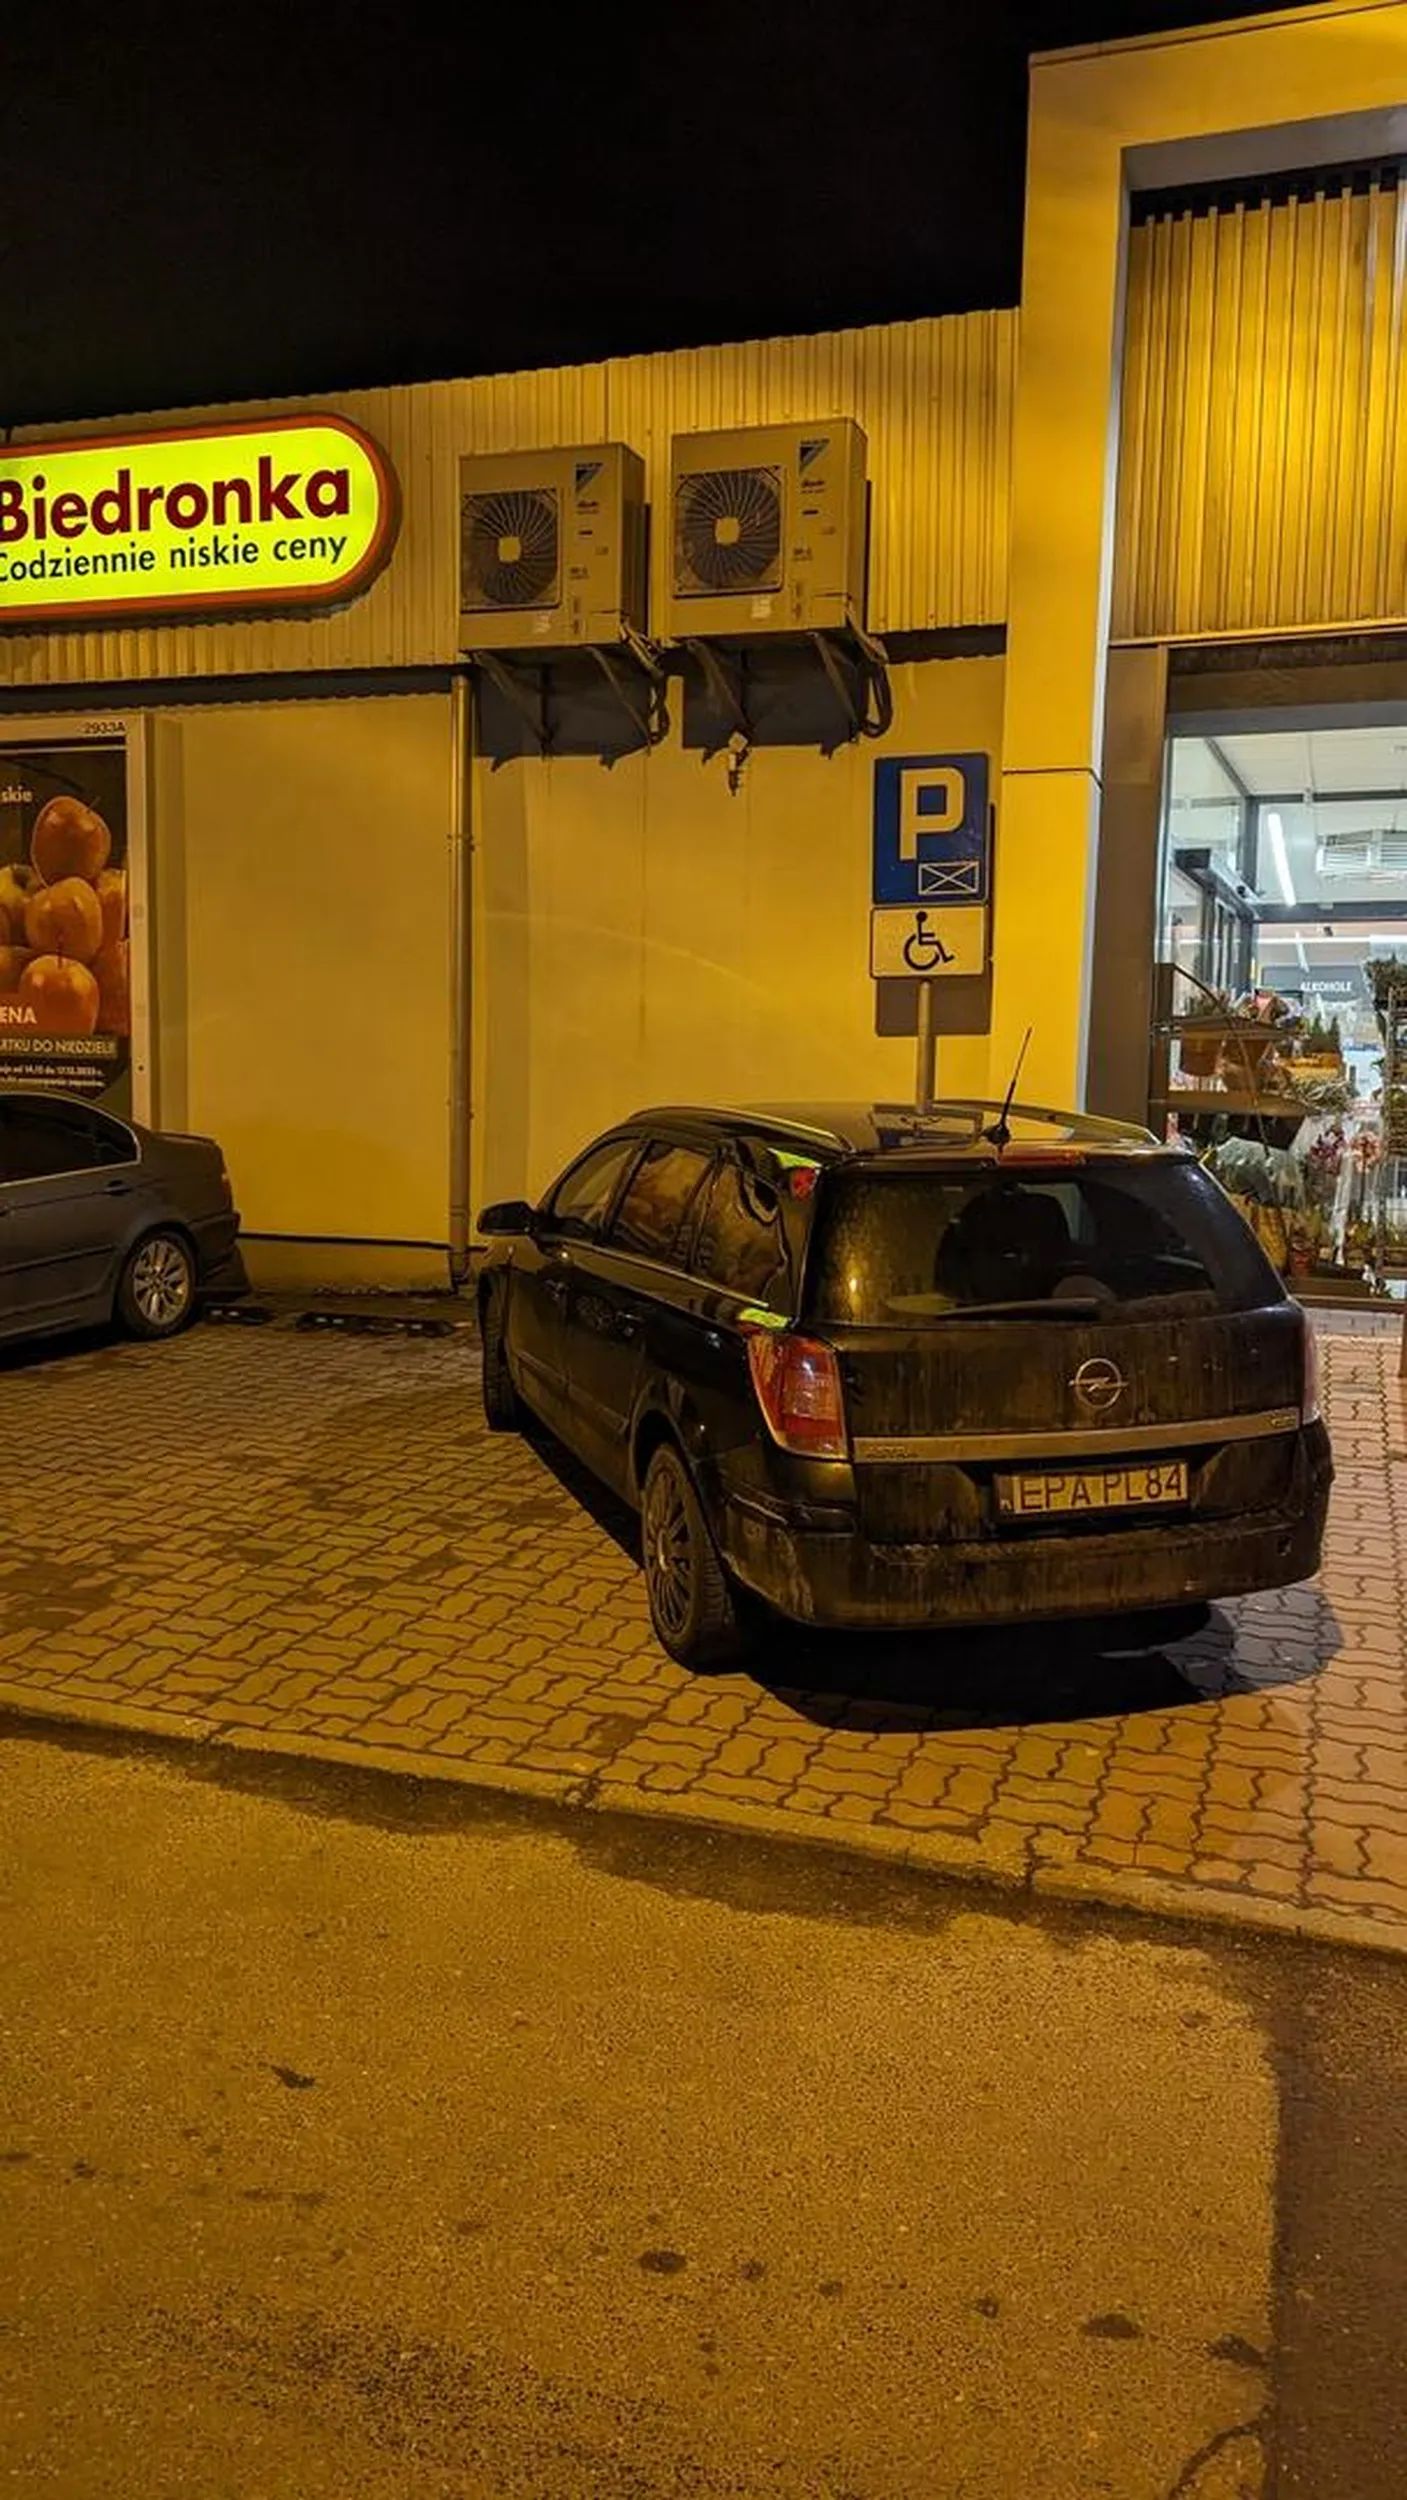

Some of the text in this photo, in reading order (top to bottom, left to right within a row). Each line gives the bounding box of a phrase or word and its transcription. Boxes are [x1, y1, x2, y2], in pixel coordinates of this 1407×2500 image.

[0, 456, 349, 542] Biedronka
[170, 534, 259, 568] niskie
[274, 535, 348, 564] ceny
[900, 767, 965, 860] P
[0, 1006, 38, 1024] ENA
[33, 1038, 53, 1053] DO
[1020, 1463, 1182, 1510] EPA PL84
